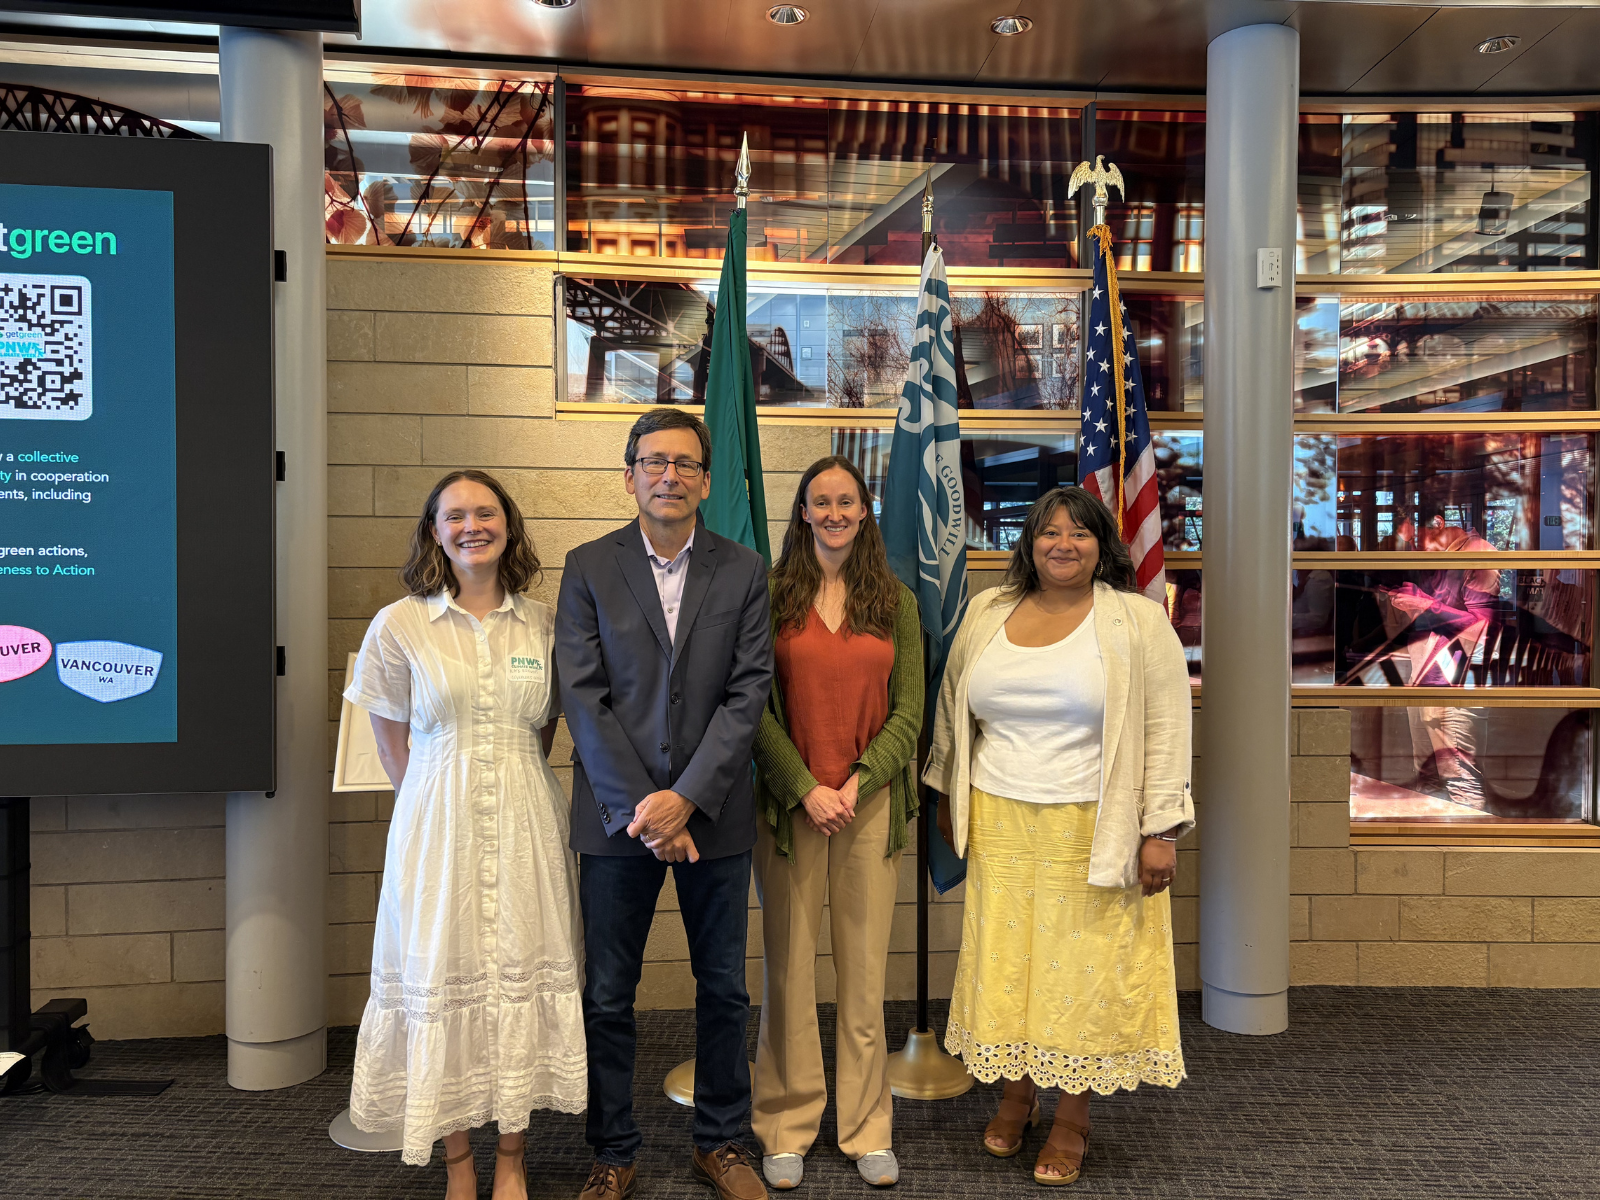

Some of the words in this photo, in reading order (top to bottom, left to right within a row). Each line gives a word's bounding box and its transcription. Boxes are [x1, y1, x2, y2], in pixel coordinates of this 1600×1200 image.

[5, 331, 43, 339] getgreen
[6, 453, 14, 462] a
[18, 451, 79, 463] collective
[15, 469, 27, 481] in
[30, 471, 109, 486] cooperation
[32, 488, 92, 504] including
[938, 465, 962, 557] GOODWILL
[0, 547, 35, 559] green
[38, 545, 89, 558] actions,
[36, 565, 50, 576] to
[53, 564, 95, 576] Action
[61, 658, 154, 677] VANCOUVER
[511, 657, 536, 666] PNW
[98, 676, 114, 684] WA
